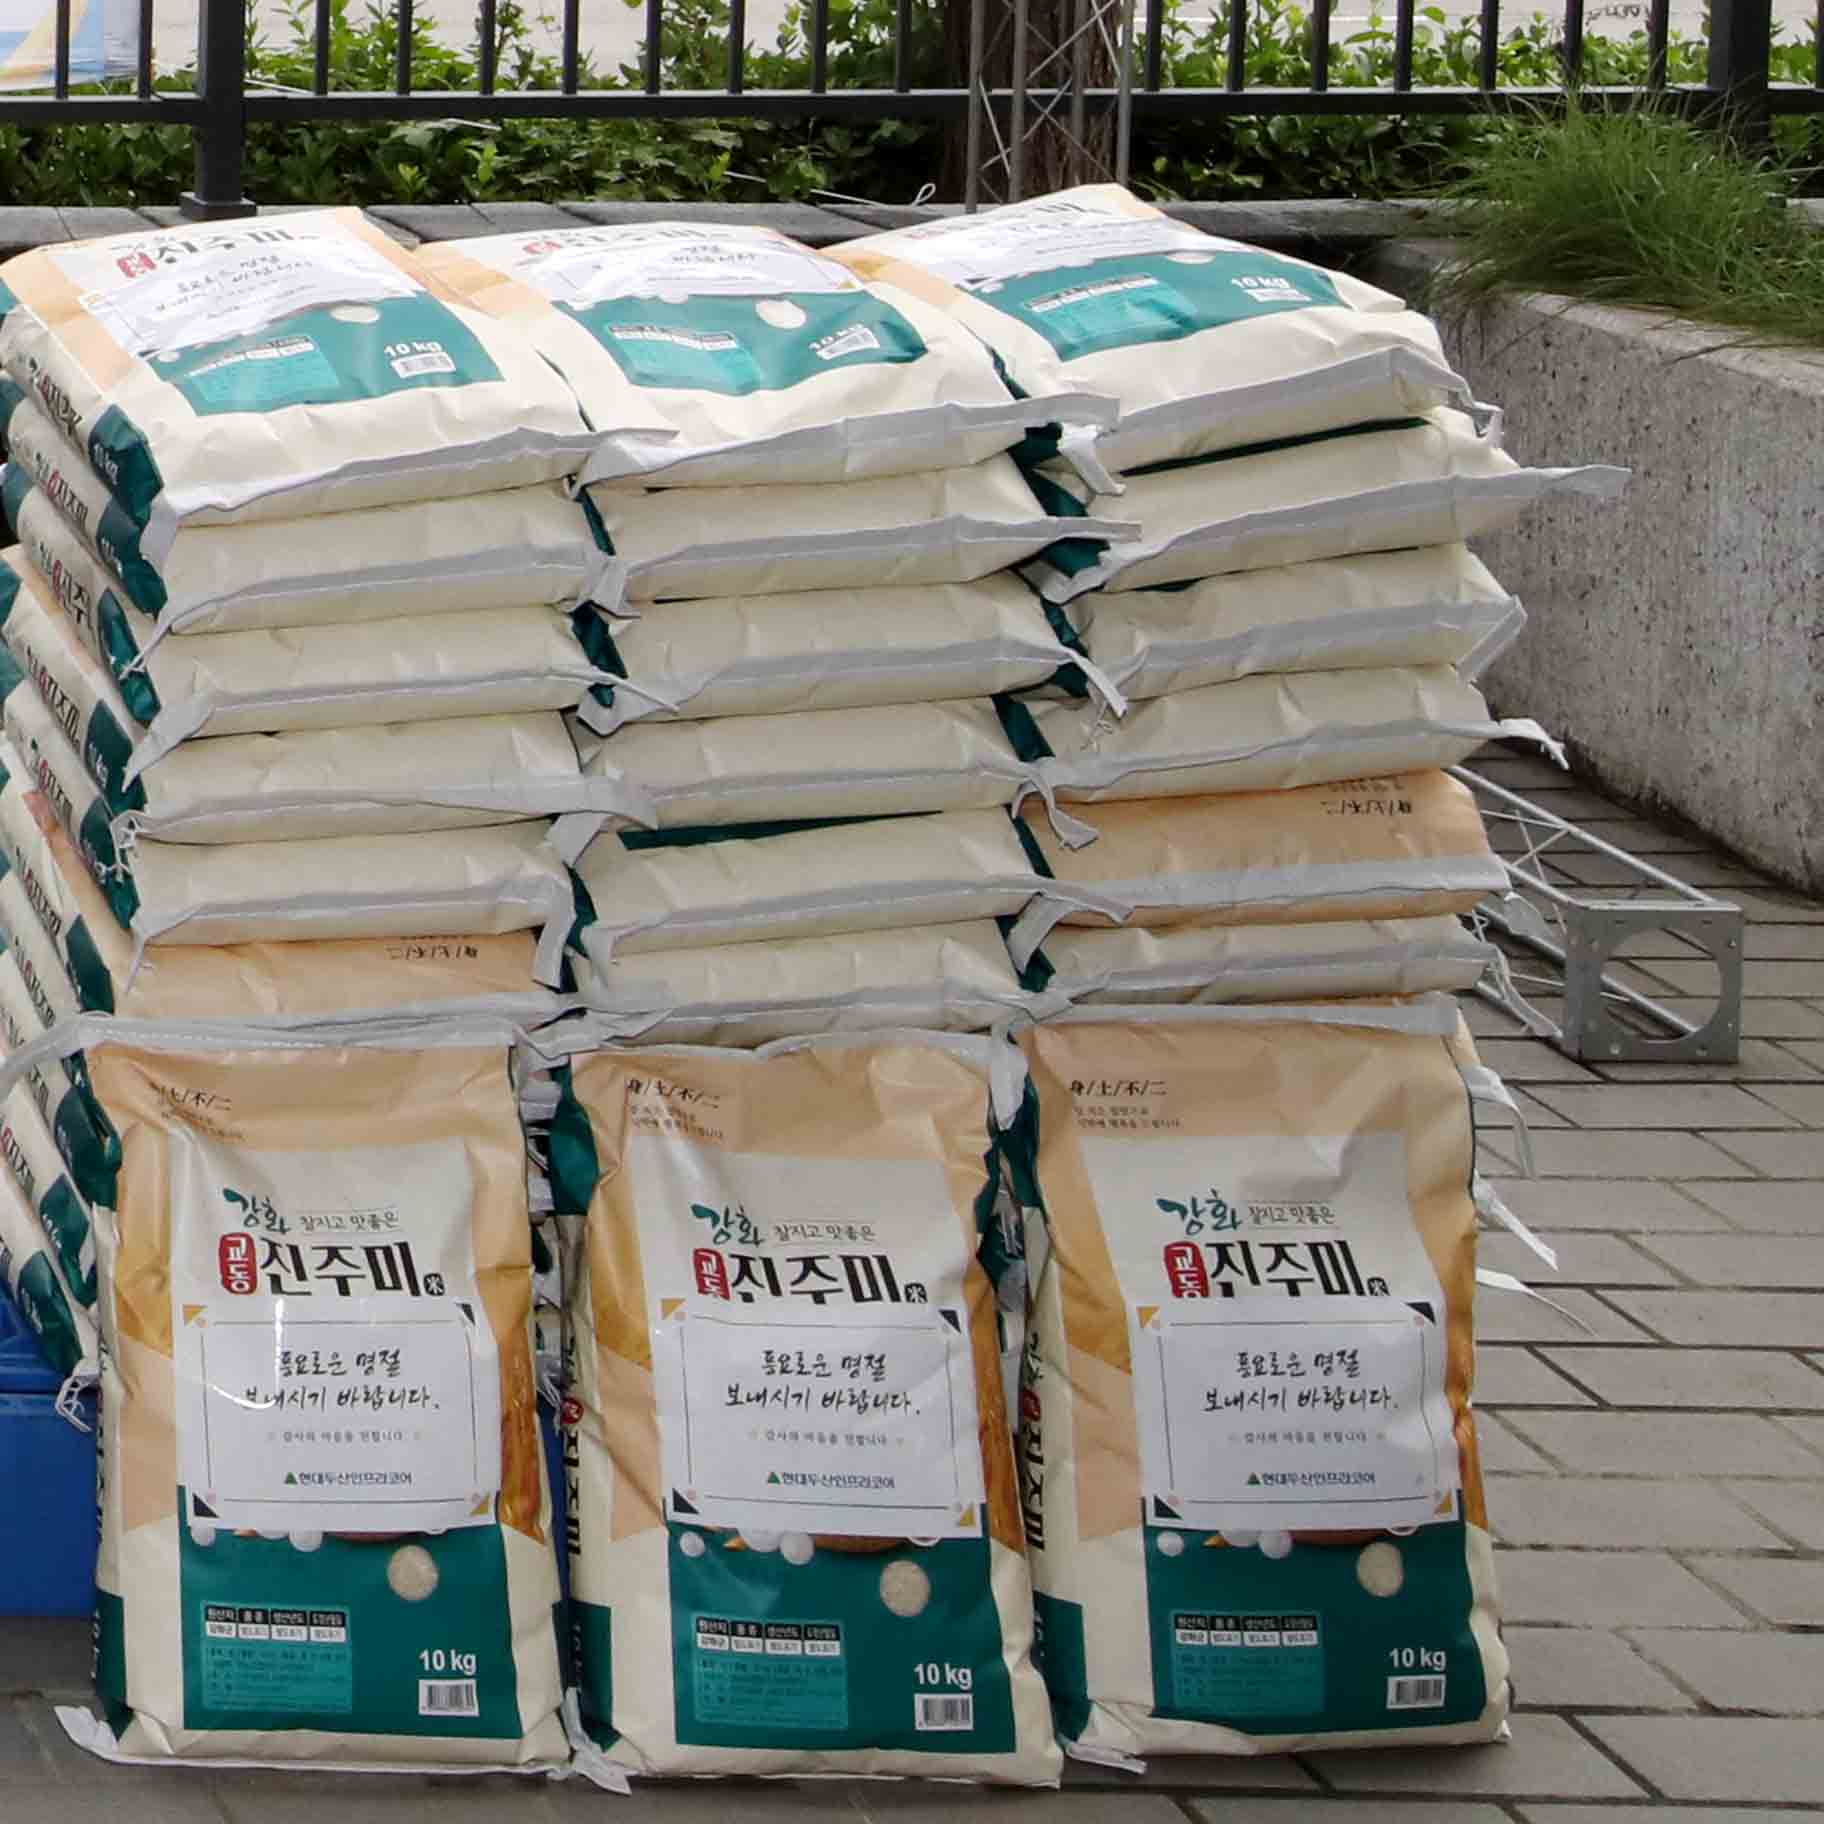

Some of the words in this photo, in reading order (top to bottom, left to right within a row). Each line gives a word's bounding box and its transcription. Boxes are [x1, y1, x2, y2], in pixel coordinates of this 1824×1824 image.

[384, 344, 410, 355] 10
[412, 341, 441, 353] kg
[223, 1187, 292, 1234] 강화
[691, 1204, 762, 1247] 강화
[1156, 1189, 1242, 1235] 강화
[223, 1235, 255, 1292] 교동
[260, 1238, 423, 1297] 진주미
[1206, 1240, 1366, 1297] 진주미
[278, 1350, 349, 1378] 풍요로운
[356, 1349, 402, 1379] 명절
[761, 1350, 832, 1378] 풍요로운
[841, 1352, 888, 1382] 명절
[1236, 1351, 1306, 1377] 풍요로운
[1313, 1349, 1360, 1377] 명절
[337, 1386, 440, 1410] 바랍니다.
[725, 1384, 811, 1409] 보내시기
[822, 1387, 921, 1416] 바랍니다.
[1203, 1389, 1287, 1412] 보내시기
[1297, 1388, 1398, 1411] 바랍니다.
[419, 1649, 446, 1670] 10
[451, 1649, 478, 1674] kg
[1389, 1649, 1416, 1668] 10
[1420, 1647, 1447, 1672] kg
[914, 1663, 941, 1685] 10
[946, 1663, 973, 1690] kg
